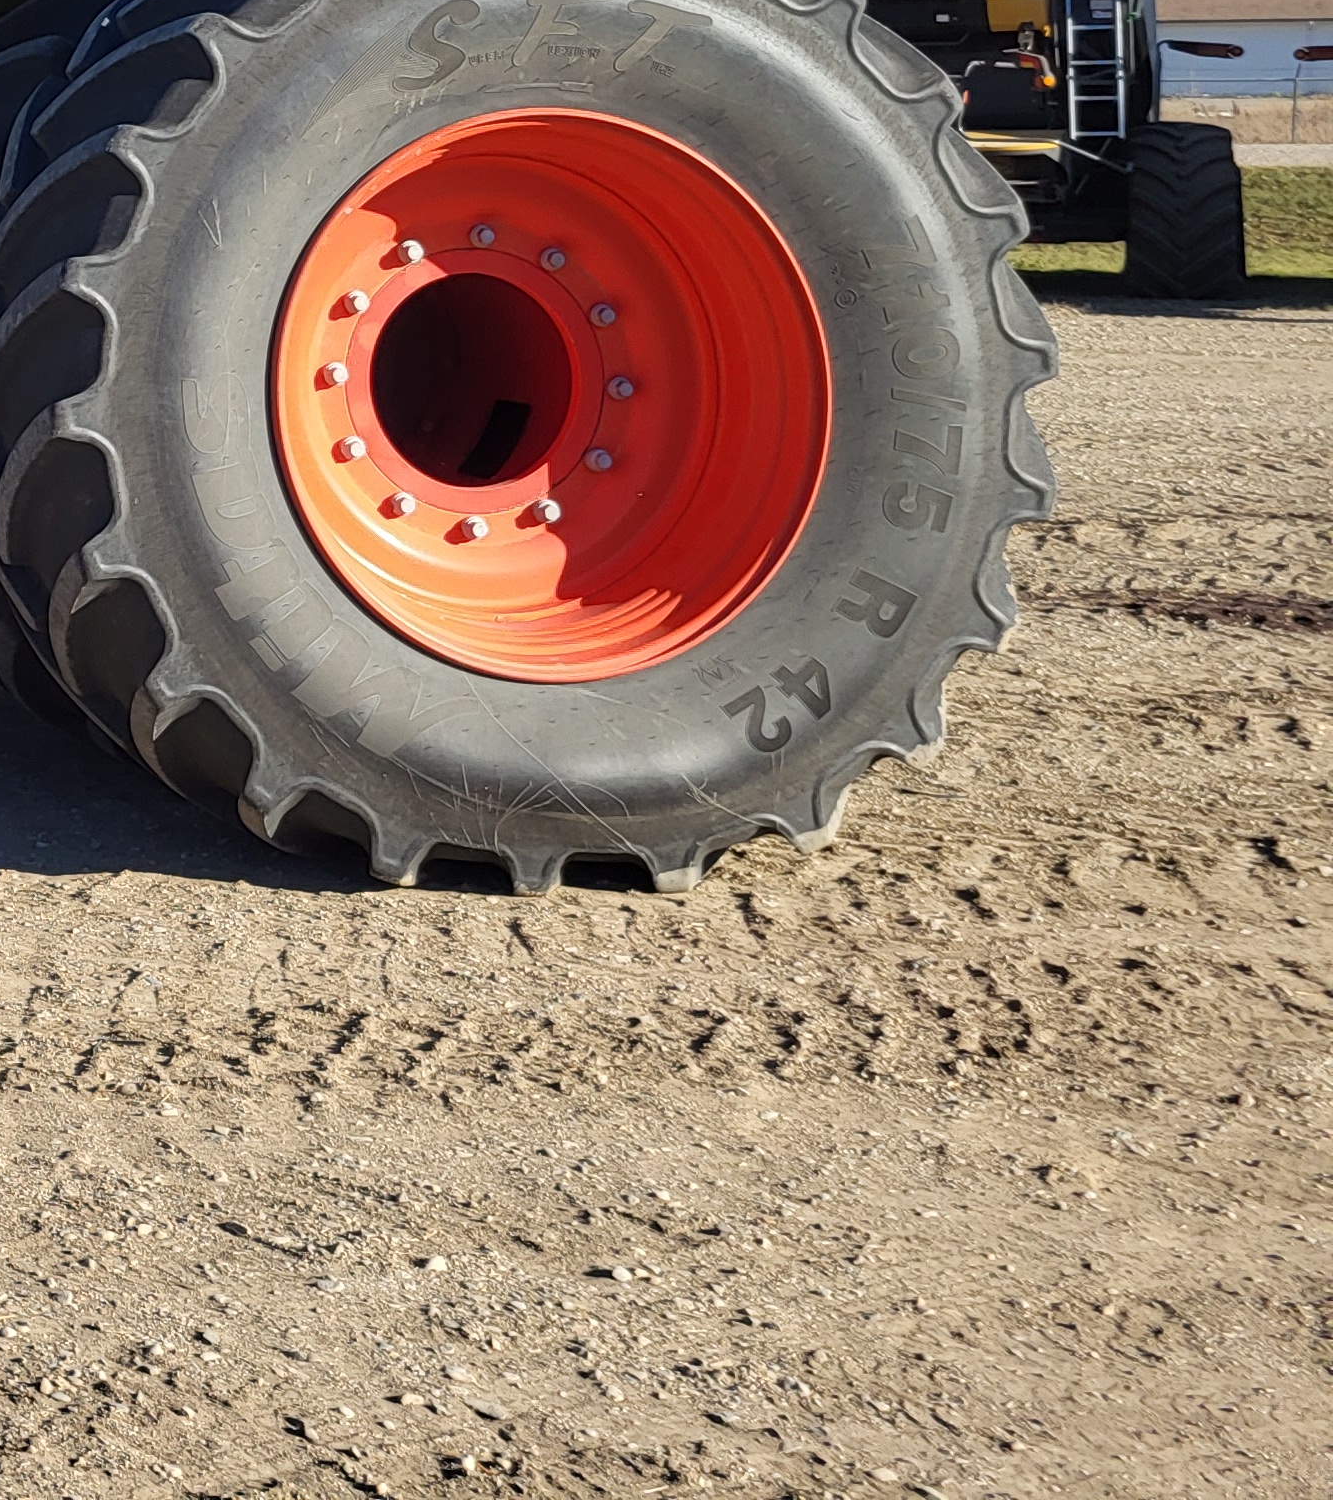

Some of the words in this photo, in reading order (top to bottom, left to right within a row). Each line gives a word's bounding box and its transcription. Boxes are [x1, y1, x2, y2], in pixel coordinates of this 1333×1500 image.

[861, 214, 968, 533] 710/75
[181, 372, 481, 758] Mitas
[832, 567, 919, 639] R
[720, 657, 832, 753] 42
